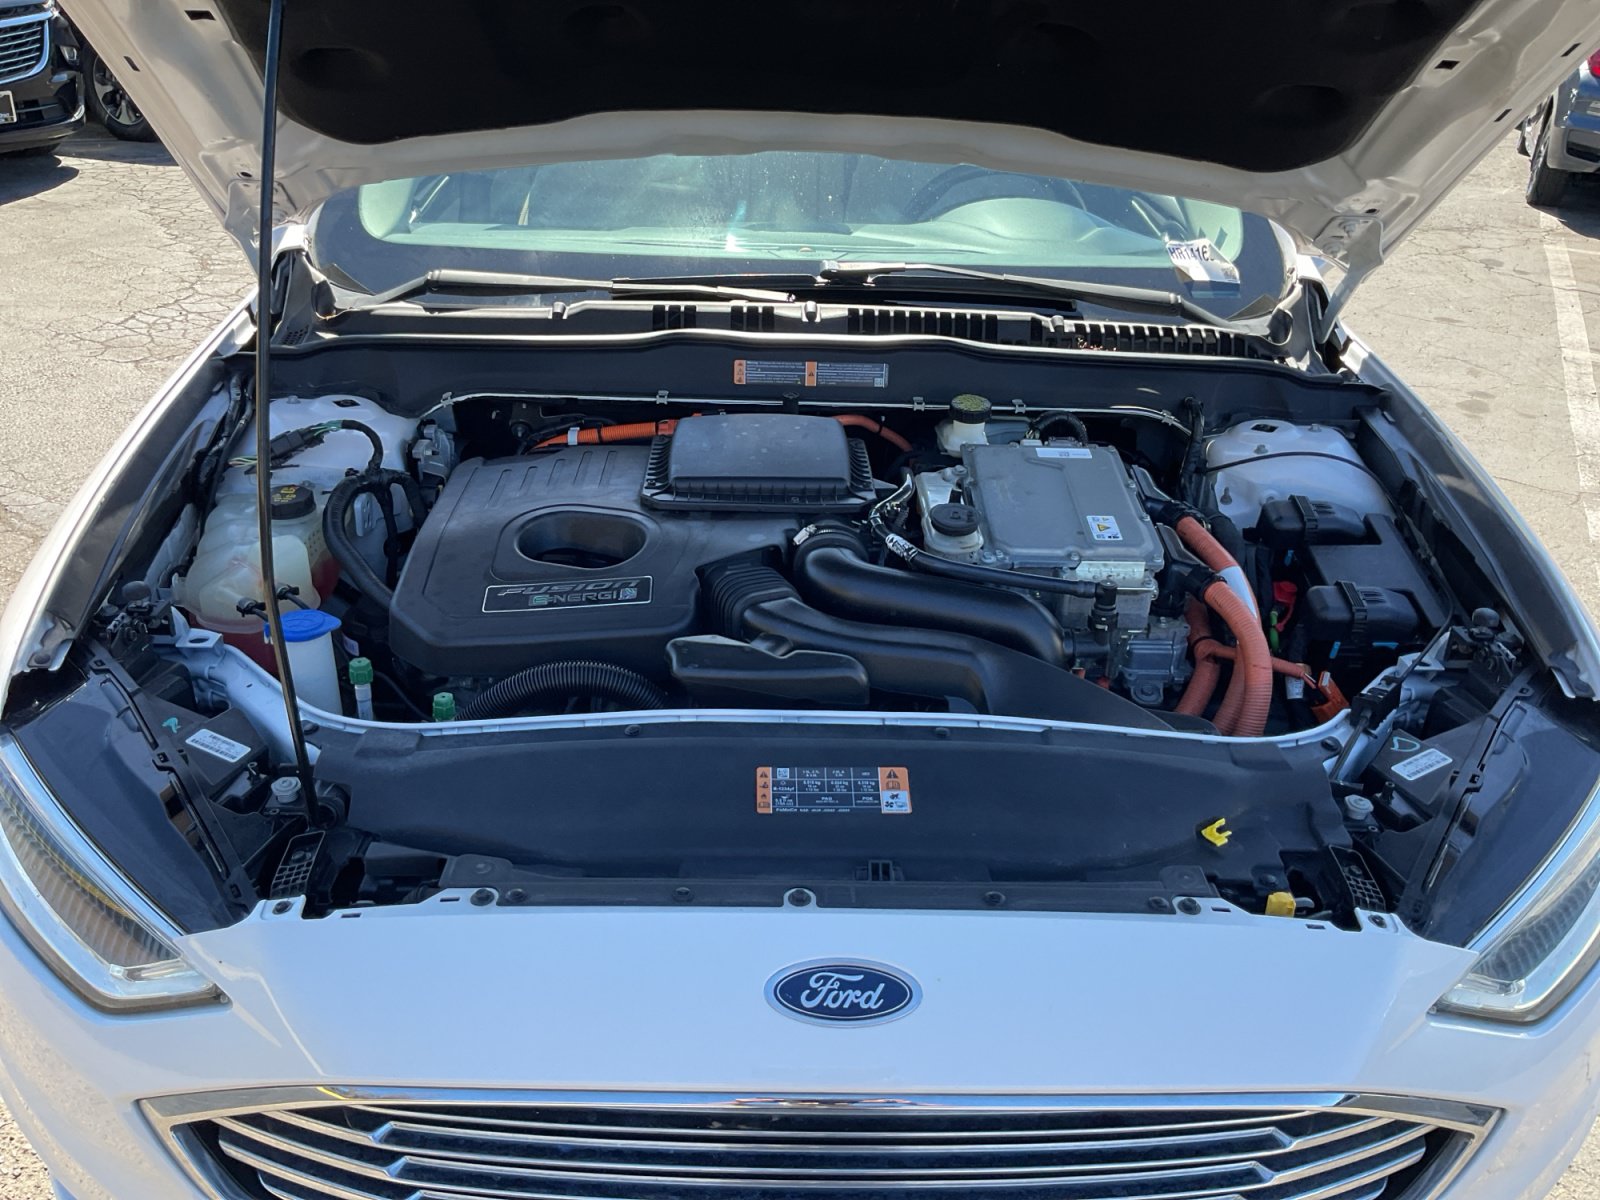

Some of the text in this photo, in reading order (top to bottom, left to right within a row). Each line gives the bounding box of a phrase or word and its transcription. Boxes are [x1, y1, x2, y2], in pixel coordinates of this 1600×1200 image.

[1168, 244, 1214, 262] HR1416
[497, 579, 641, 596] FUSION
[531, 591, 618, 606] ENERGI
[800, 972, 886, 1009] Ford
